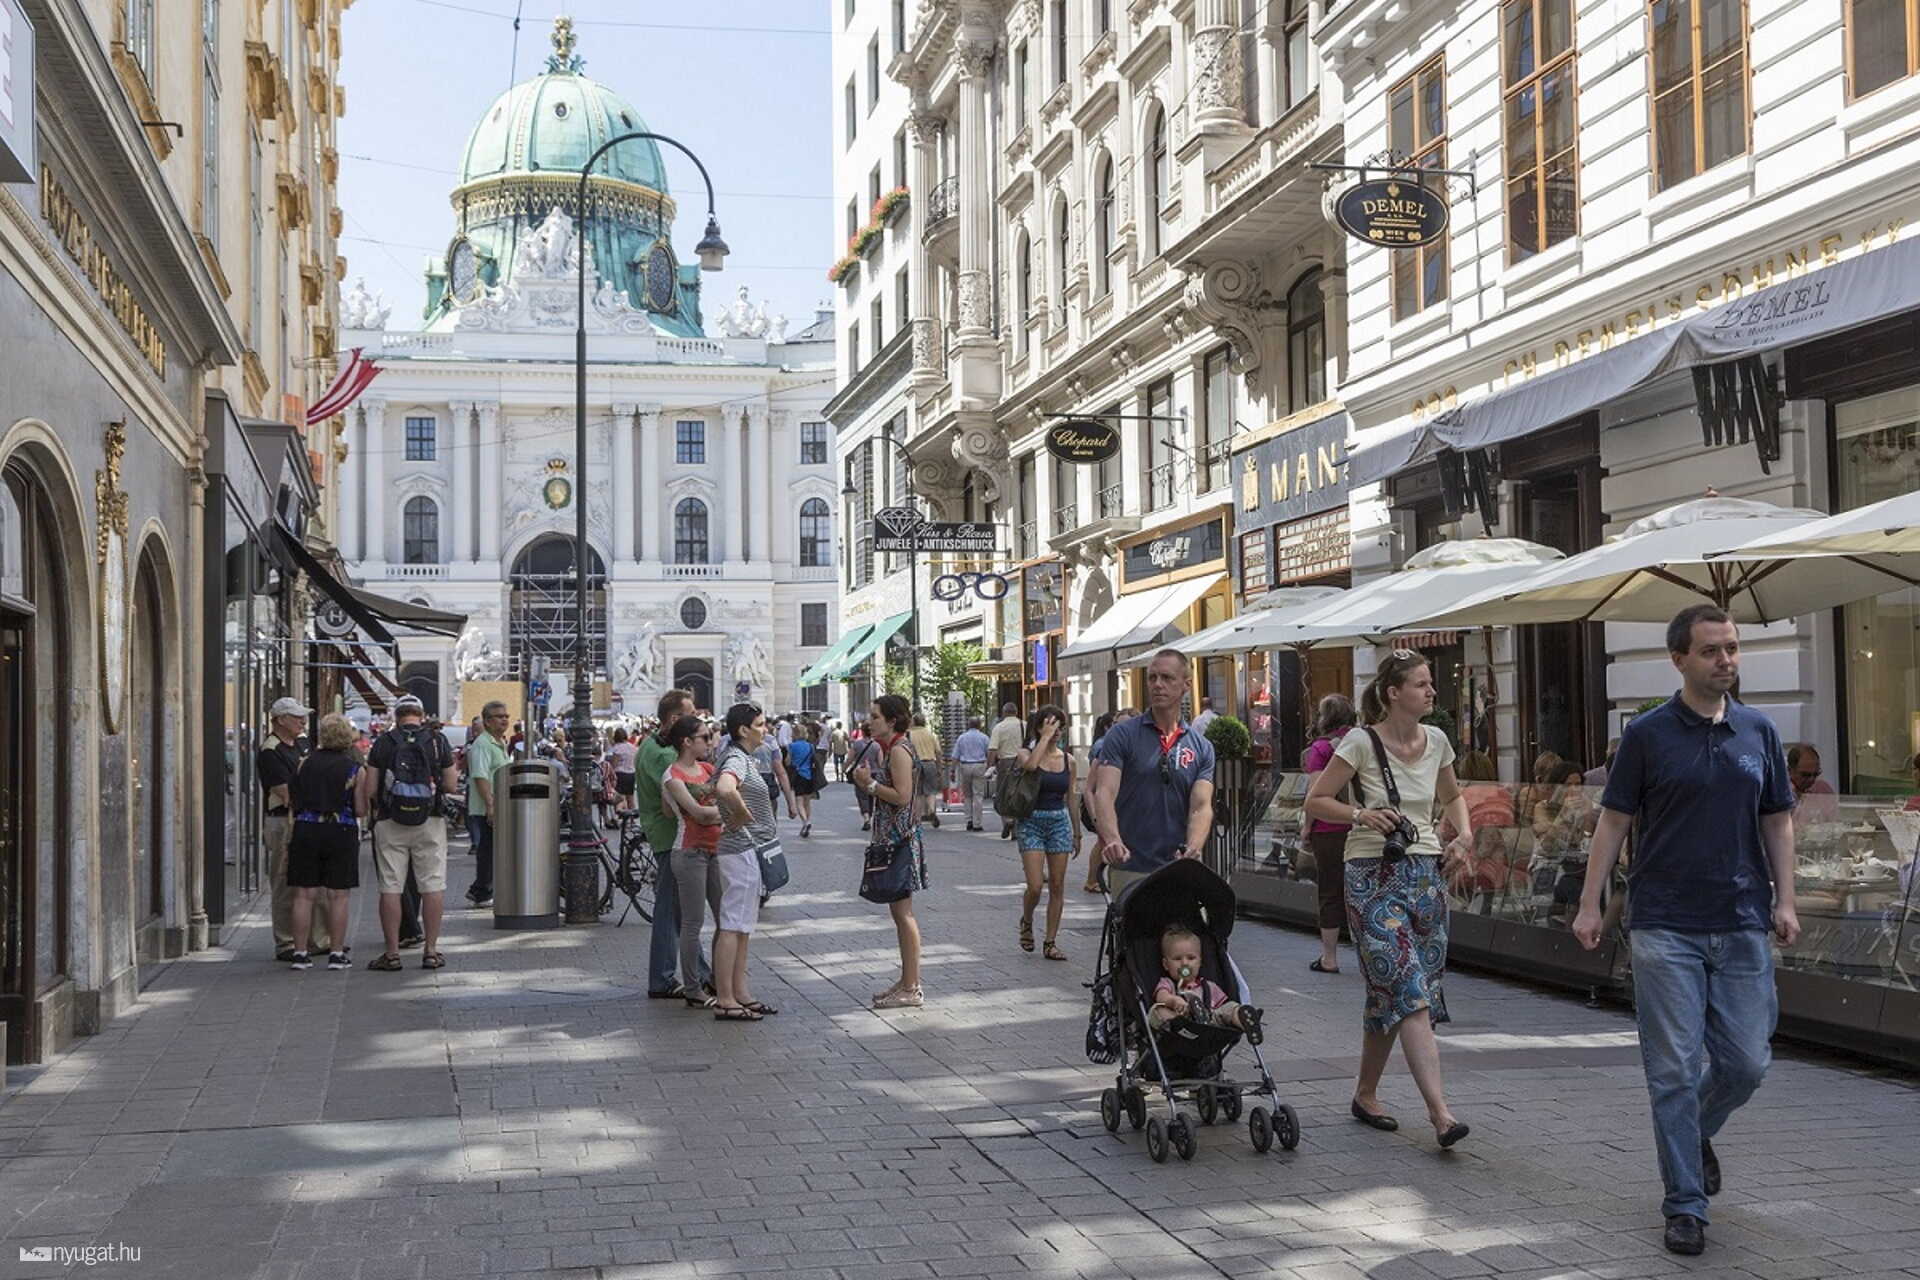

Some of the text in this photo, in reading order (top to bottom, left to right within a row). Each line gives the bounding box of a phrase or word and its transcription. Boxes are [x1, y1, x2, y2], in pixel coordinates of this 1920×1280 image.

[1362, 198, 1427, 218] DEMEL
[1714, 281, 1830, 329] DEMEL
[1052, 428, 1113, 450] Chopard
[1271, 440, 1349, 504] MAN
[943, 527, 954, 538] &
[923, 538, 994, 550] ANTIKSCHMUCK
